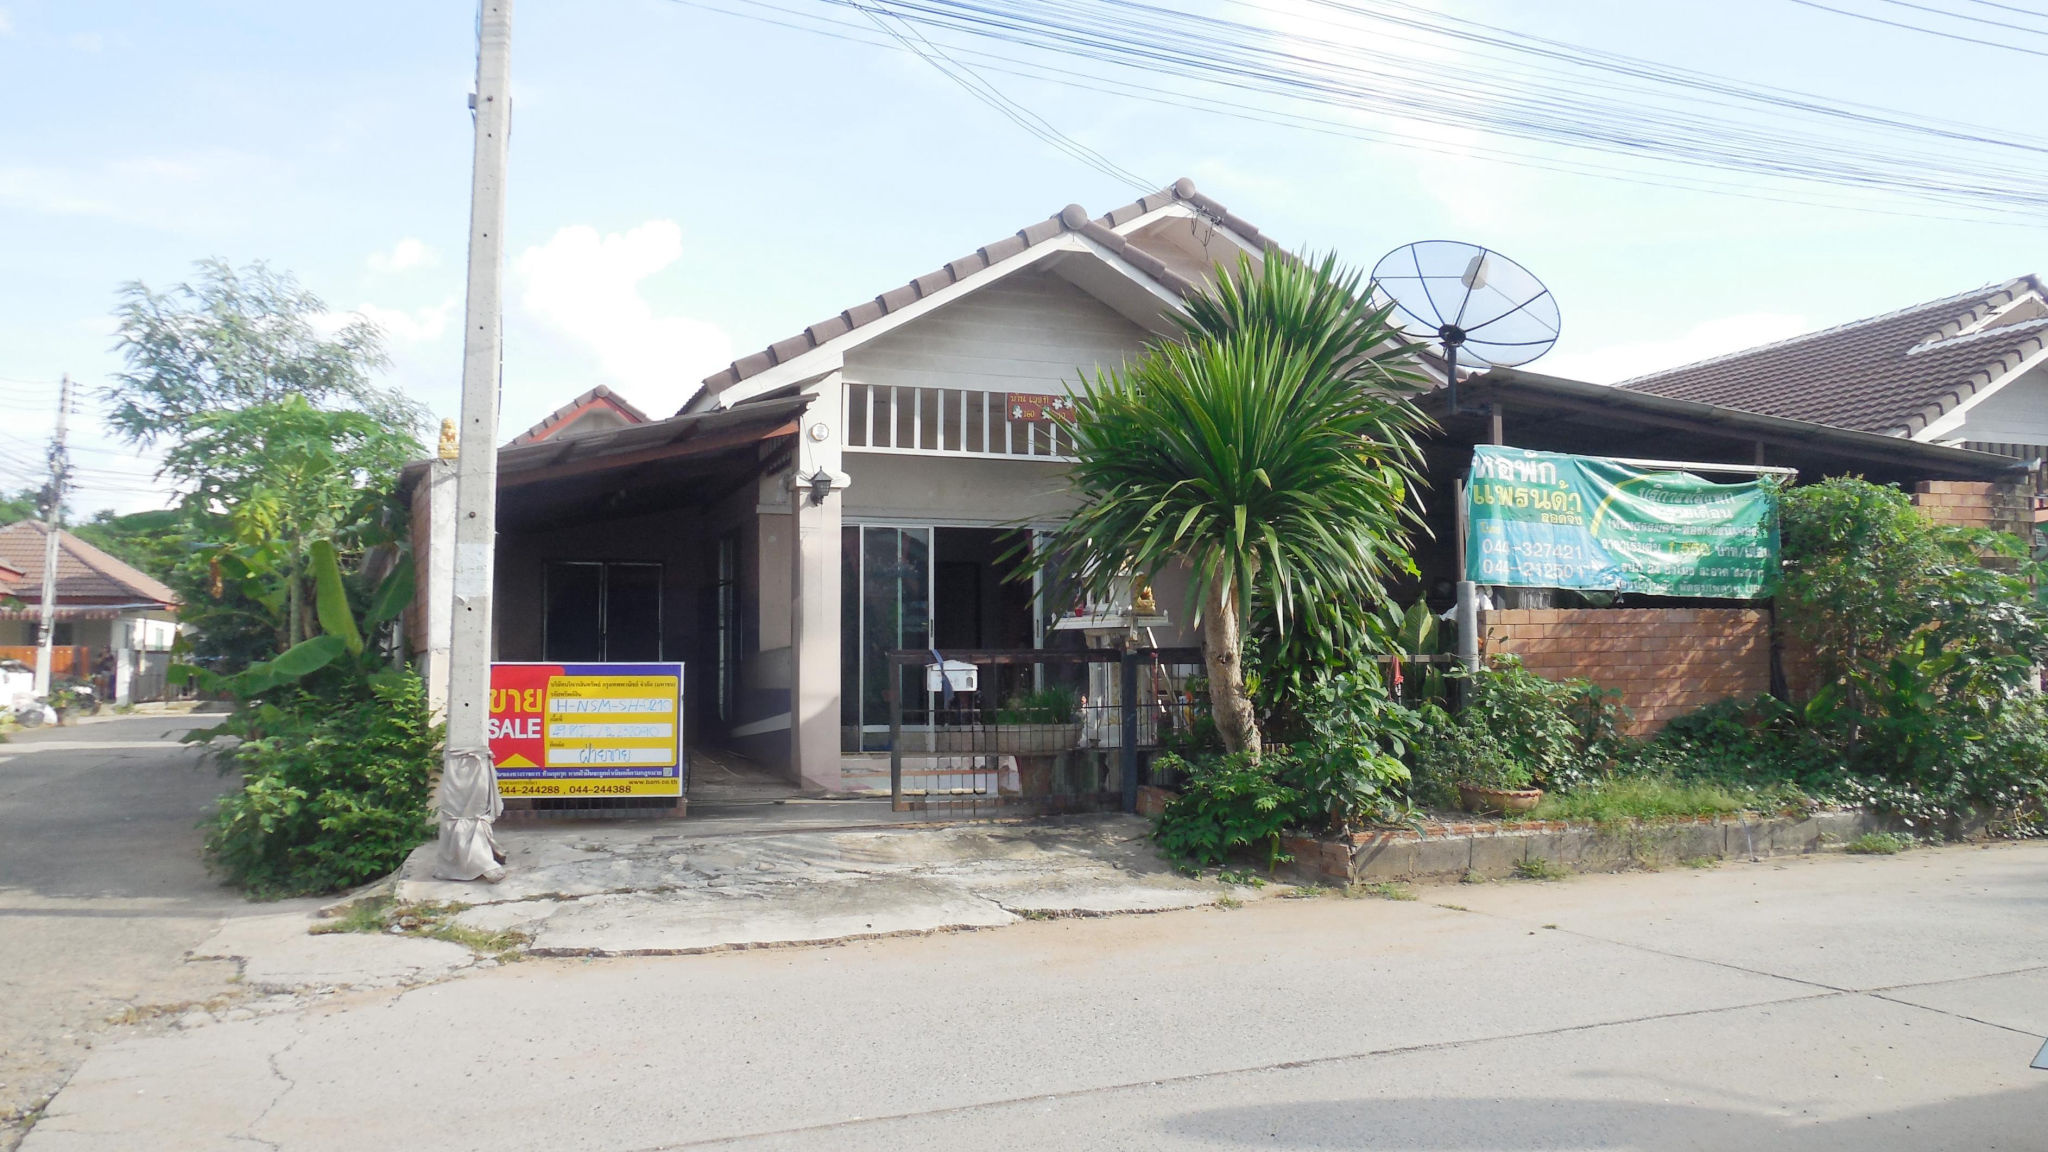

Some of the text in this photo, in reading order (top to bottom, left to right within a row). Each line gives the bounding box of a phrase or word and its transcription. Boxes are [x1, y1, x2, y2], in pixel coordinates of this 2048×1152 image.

[1472, 451, 1557, 485] หอพัก
[1473, 480, 1582, 512] แพรนด้า
[1482, 538, 1582, 560] 044-327421
[489, 688, 543, 713] ขาย
[488, 718, 541, 739] SALE
[498, 785, 560, 794] 044-244288
[569, 785, 632, 794] 044-244388
